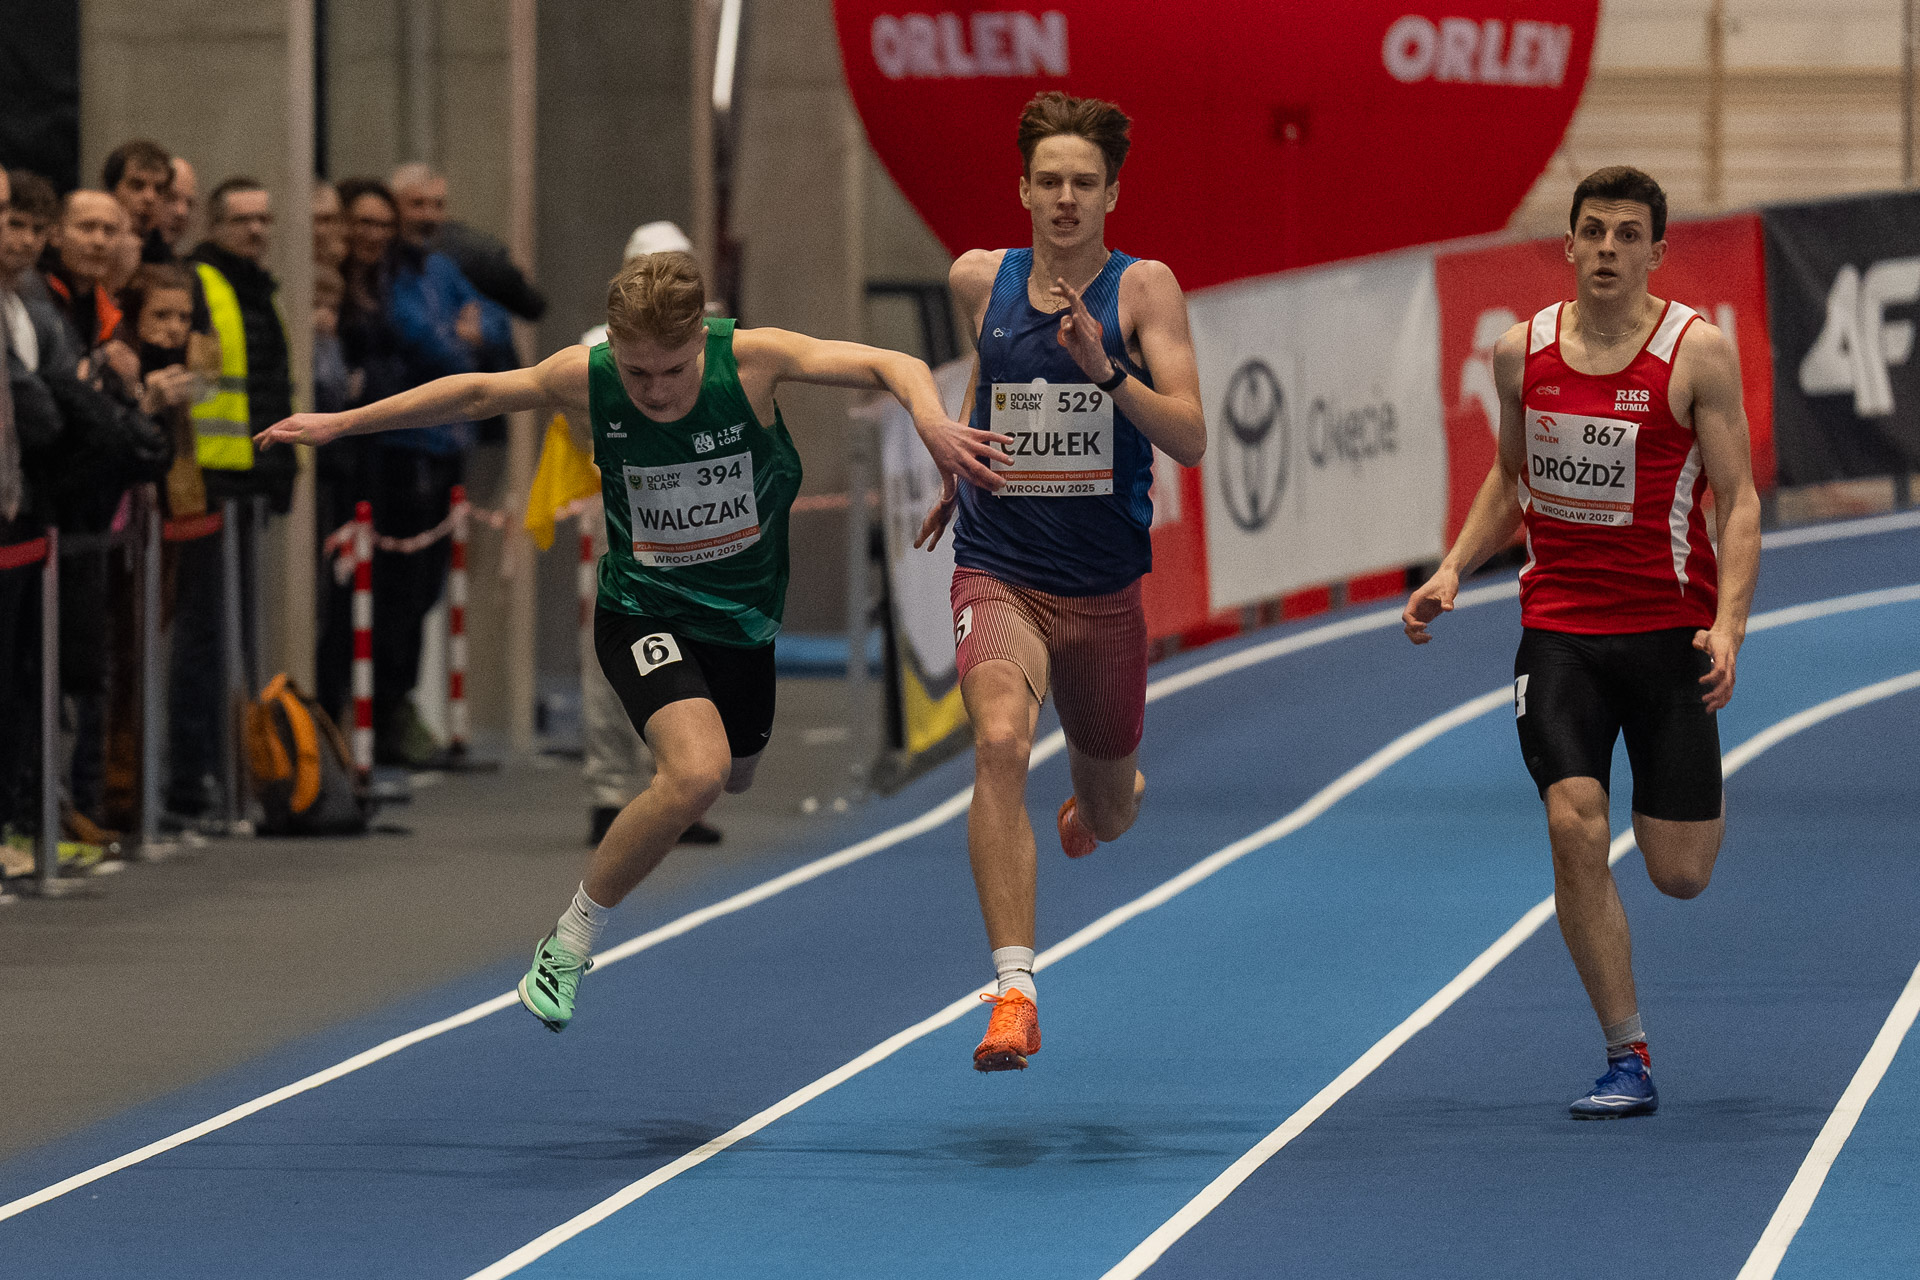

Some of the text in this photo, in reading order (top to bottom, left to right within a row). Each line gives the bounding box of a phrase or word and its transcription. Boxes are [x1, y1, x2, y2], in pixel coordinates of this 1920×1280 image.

[869, 11, 1070, 79] ORLEN
[1380, 15, 1573, 88] ORLEN
[1010, 393, 1044, 402] DOLNY
[1057, 391, 1103, 413] 529
[1615, 389, 1650, 402] RKS
[1010, 401, 1042, 411] ŚLĄSK
[1614, 403, 1650, 412] RUMIA
[718, 434, 742, 446] ŁÓDŹ
[1534, 435, 1559, 444] ORLEN
[1582, 423, 1627, 447] 867
[646, 471, 681, 484] DOLNY
[697, 460, 742, 486] 394
[1532, 453, 1626, 488] DRÓŻDŻ
[648, 480, 681, 491] ŚLĄSK
[1006, 483, 1096, 493] WROCŁAW 2025
[637, 493, 751, 531] WALCZAK
[1540, 503, 1615, 523] WROCŁAW 2025
[653, 542, 744, 564] WROCŁAW 2025
[643, 630, 670, 665] 6
